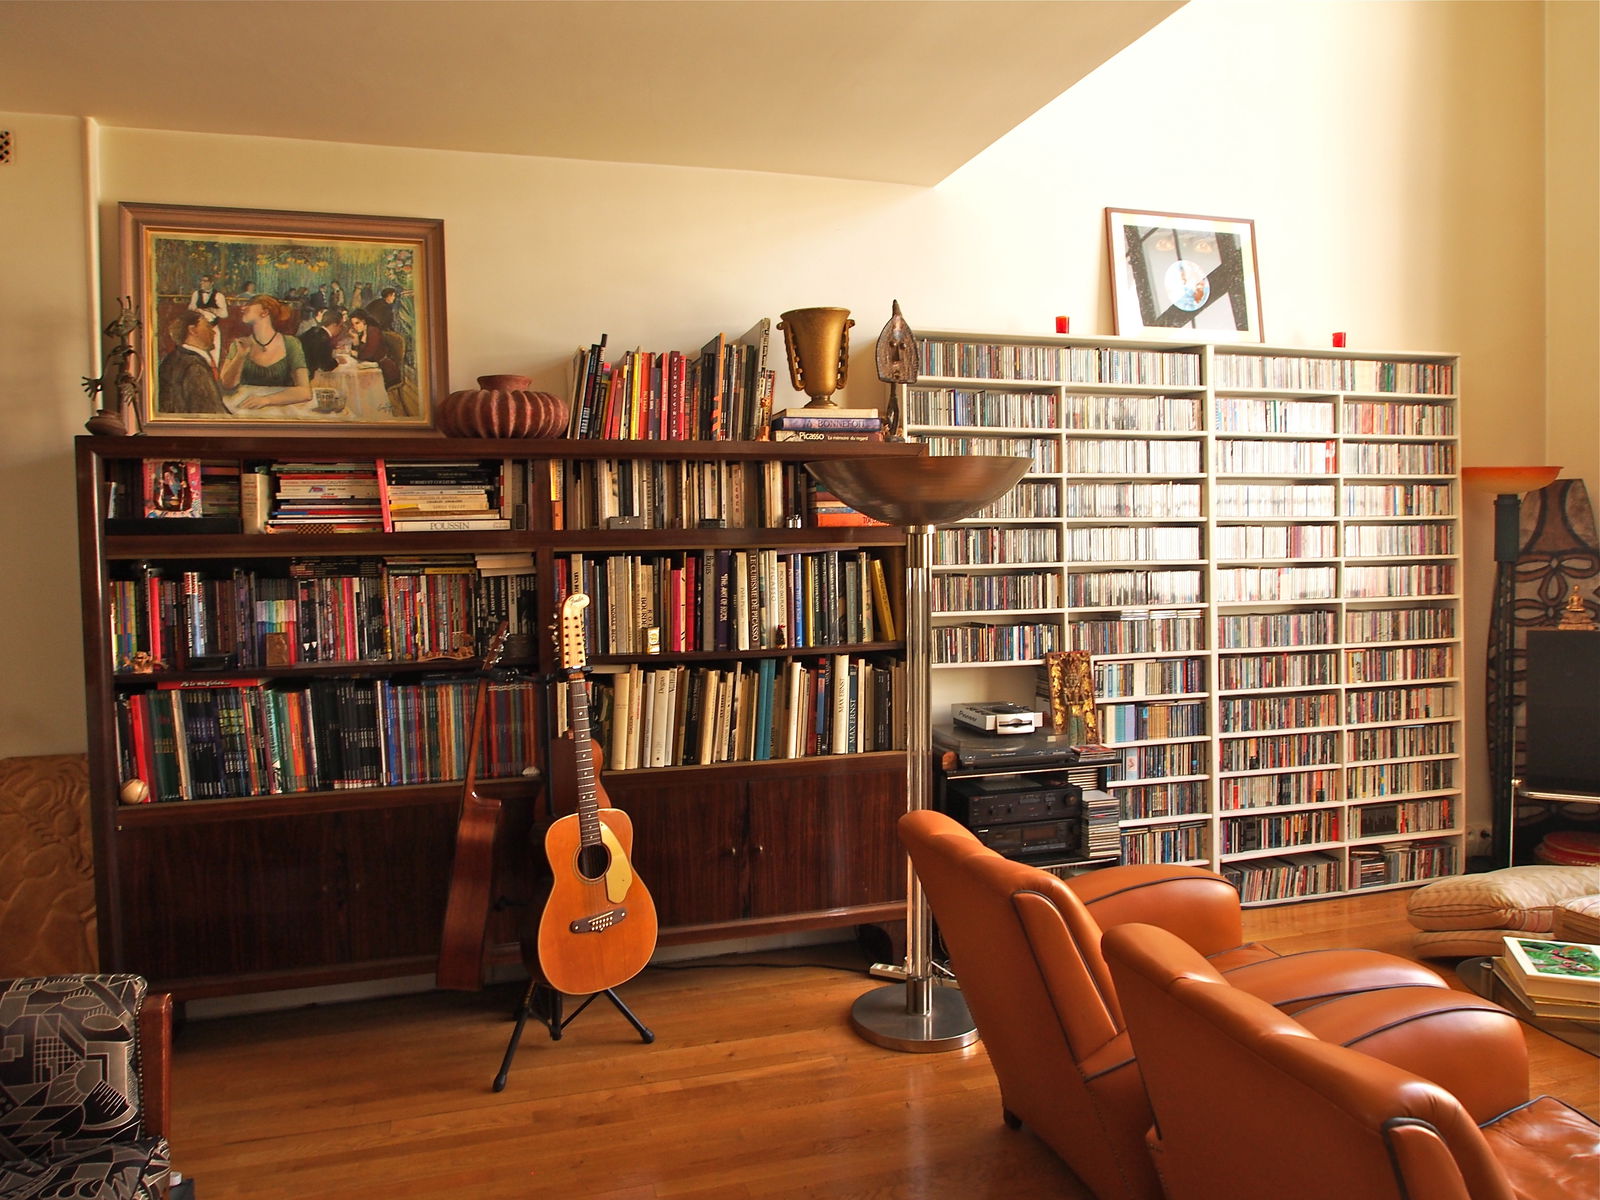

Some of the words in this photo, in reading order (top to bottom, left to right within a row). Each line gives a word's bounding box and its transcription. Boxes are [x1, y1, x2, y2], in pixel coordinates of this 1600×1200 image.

[798, 431, 825, 440] Picasso
[430, 522, 470, 530] POUSSIN
[750, 565, 758, 598] CUBISME
[751, 610, 759, 641] PICASSO
[658, 676, 666, 694] Degas
